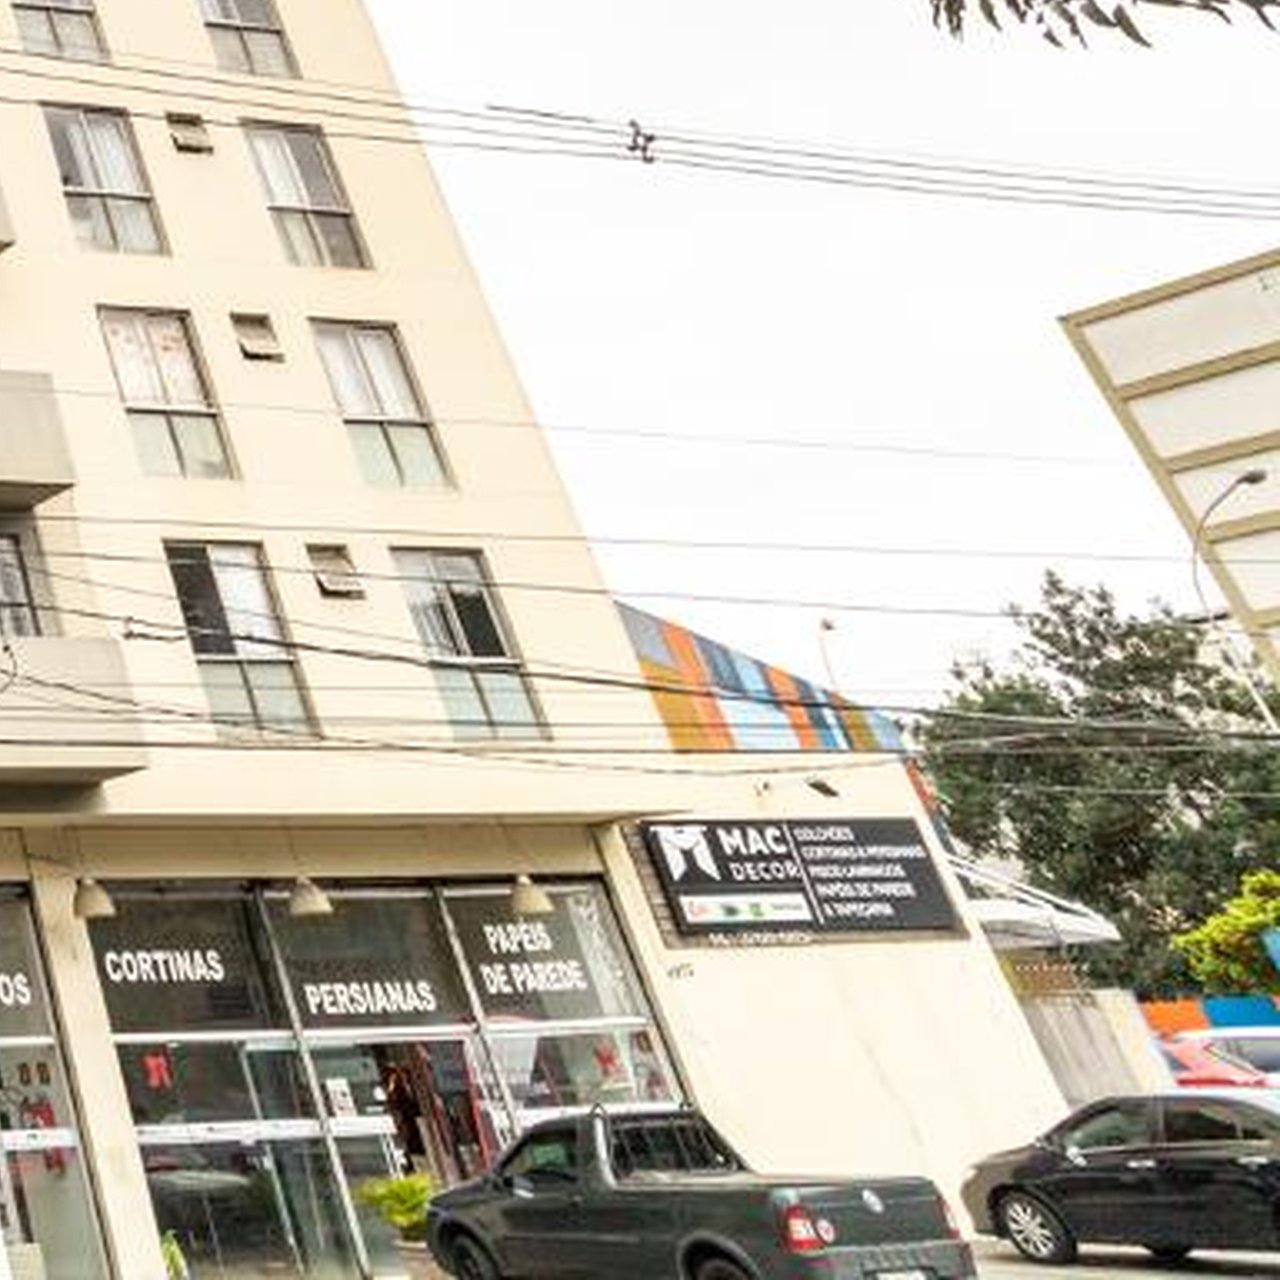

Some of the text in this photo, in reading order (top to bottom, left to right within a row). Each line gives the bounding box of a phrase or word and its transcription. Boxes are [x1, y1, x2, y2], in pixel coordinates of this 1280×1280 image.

[716, 825, 788, 856] MAC
[729, 860, 802, 881] DECOR
[482, 917, 553, 955] PAPÉIS
[104, 949, 225, 983] CORTINAS
[479, 959, 588, 995] DE PAREDE
[303, 980, 437, 1015] PERSIANAS
